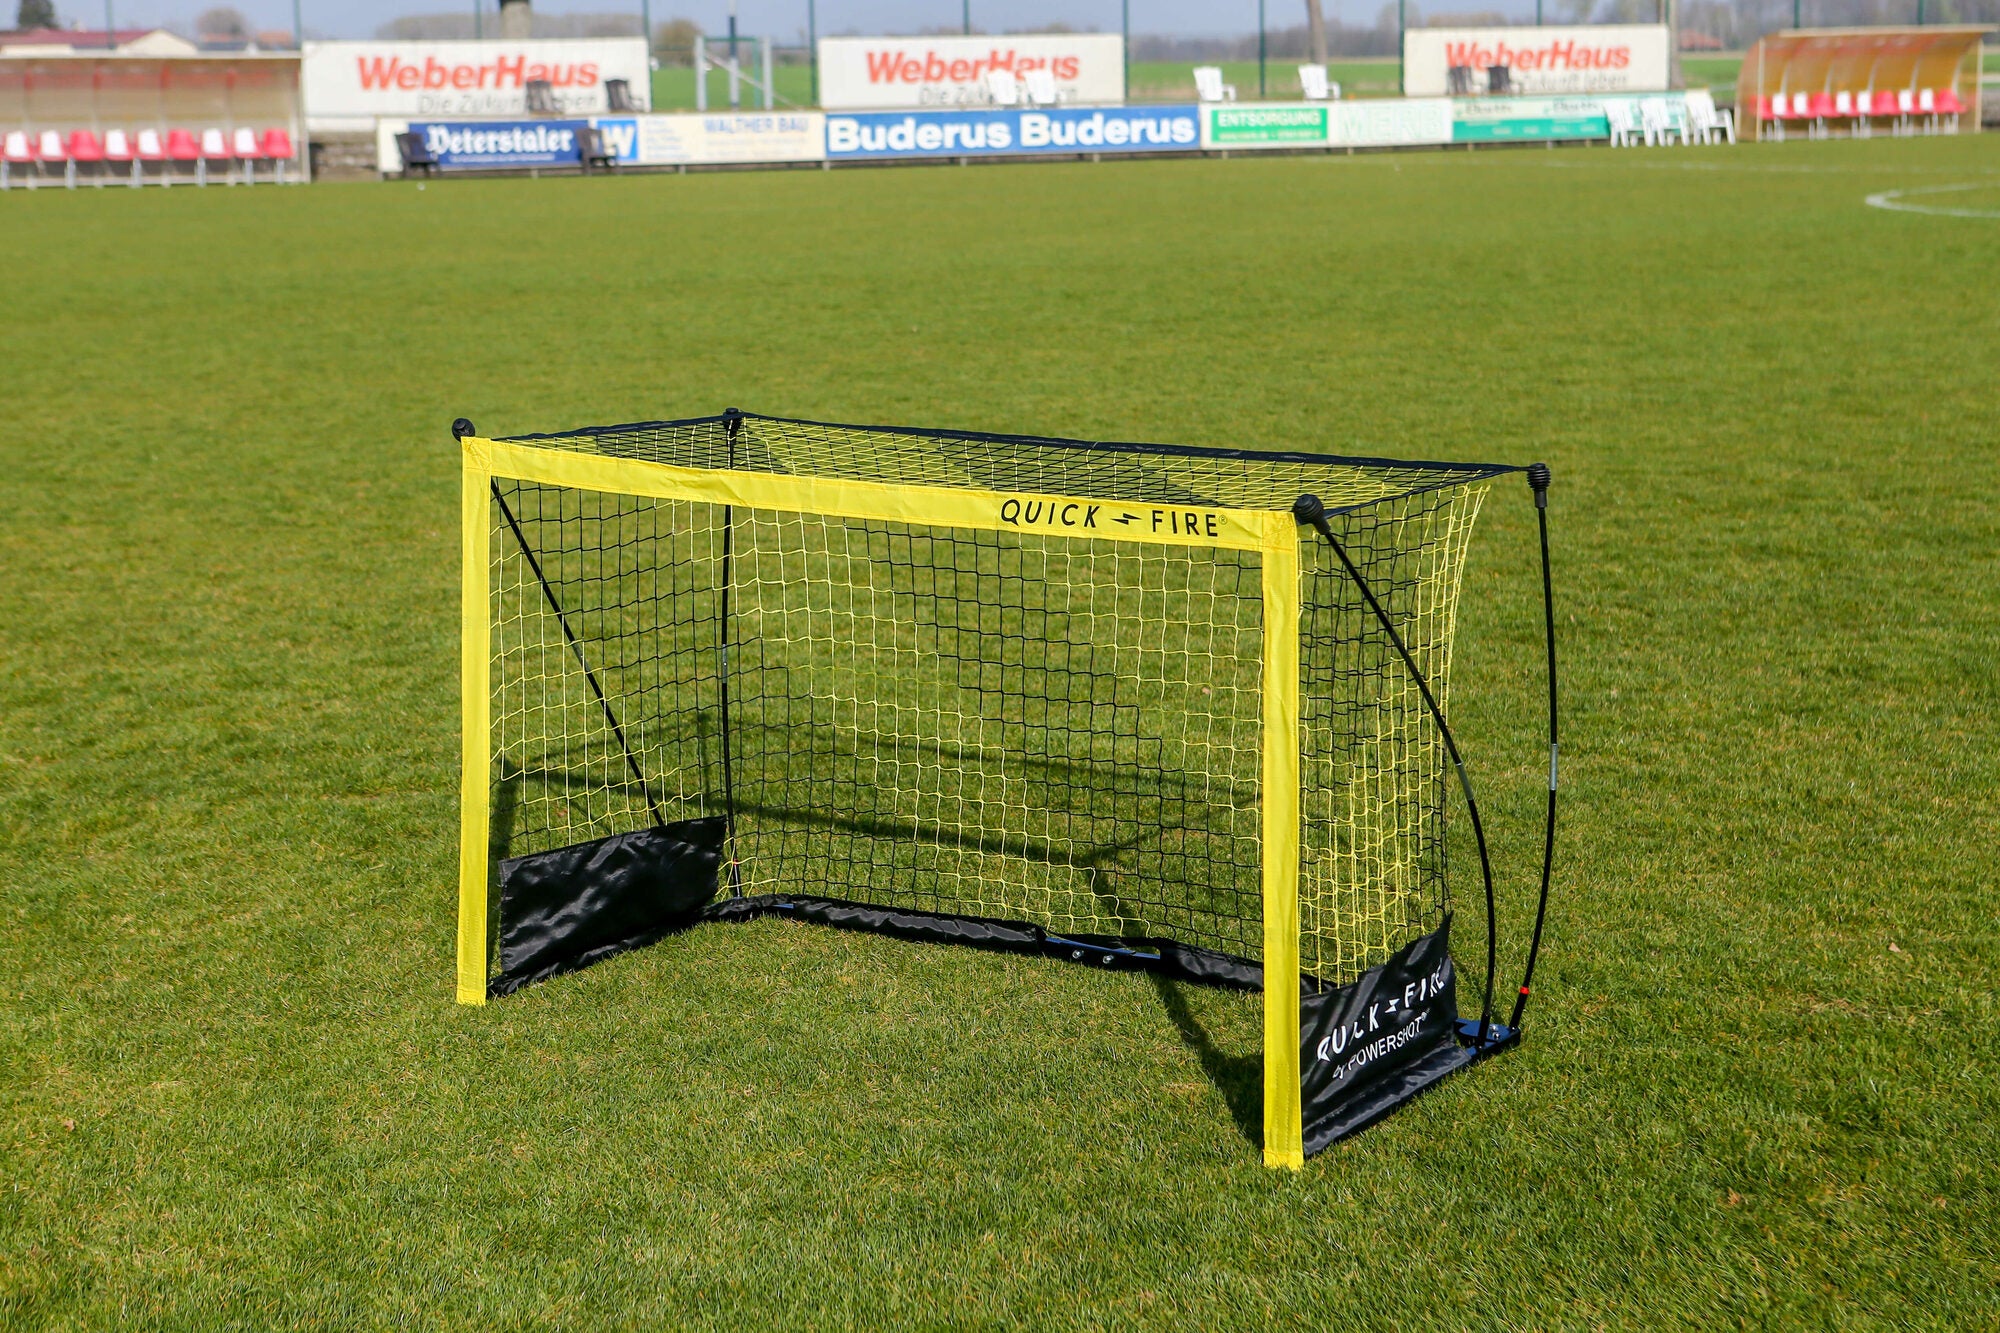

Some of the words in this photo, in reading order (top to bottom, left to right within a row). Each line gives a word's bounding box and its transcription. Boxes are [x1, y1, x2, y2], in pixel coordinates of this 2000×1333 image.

[866, 50, 1079, 84] WeberHaus
[1445, 40, 1630, 71] WeberHaus
[357, 55, 598, 90] WeberHaus
[704, 117, 774, 134] WALTHER
[777, 116, 809, 132] BAU
[828, 117, 1011, 153] Buderus
[1020, 112, 1196, 148] Buderus
[1217, 111, 1321, 127] ENTSORGUNG
[425, 126, 574, 155] Peterstaler
[601, 125, 634, 157] W
[1001, 499, 1100, 528] QUICK
